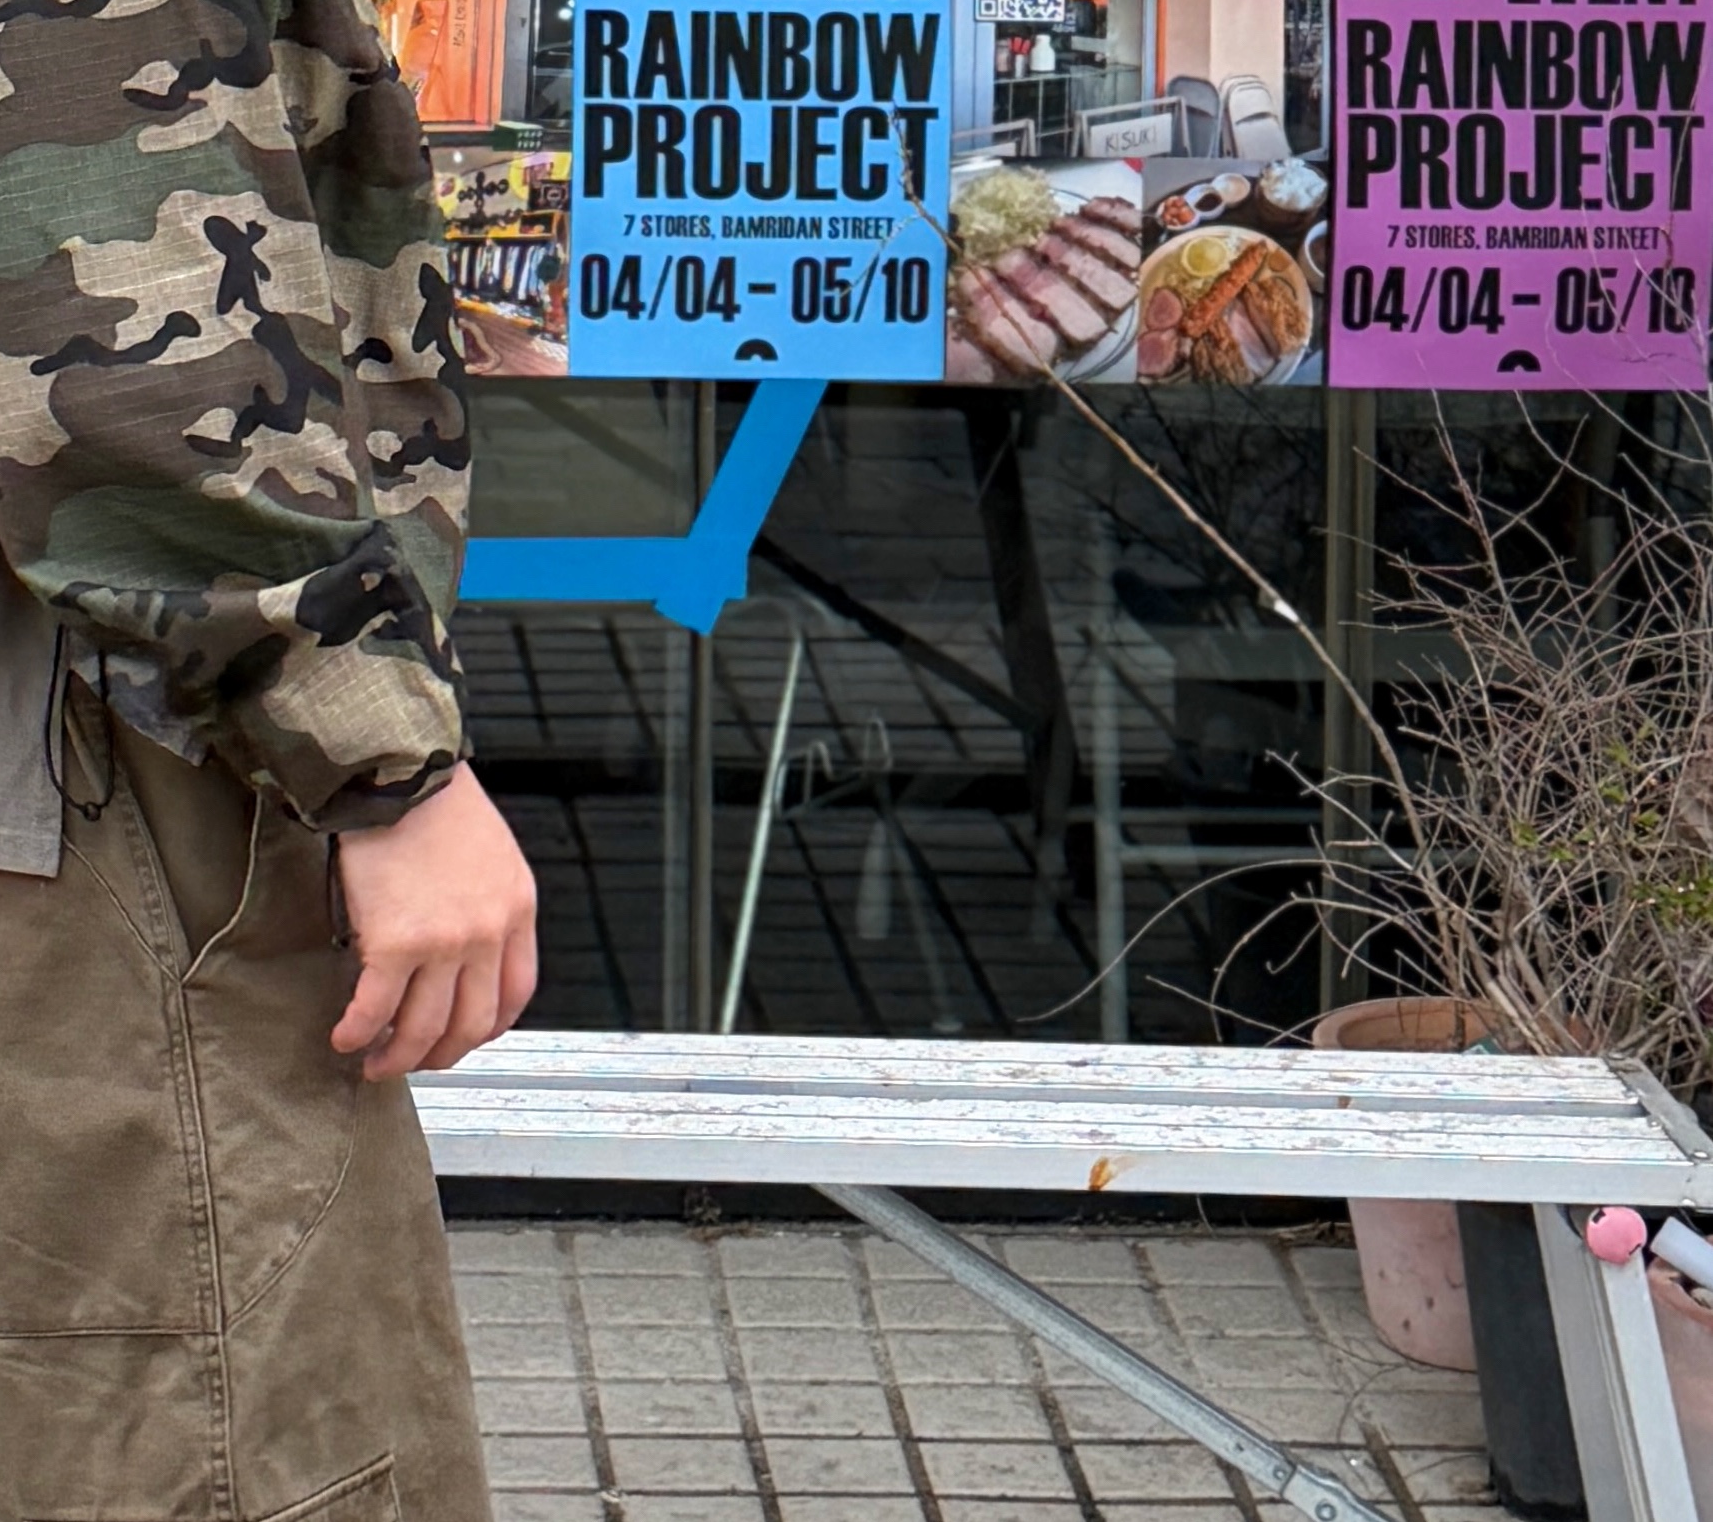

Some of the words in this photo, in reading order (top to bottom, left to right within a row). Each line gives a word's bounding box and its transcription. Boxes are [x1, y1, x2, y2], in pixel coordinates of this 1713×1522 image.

[585, 11, 938, 101] RAINBOW
[1347, 19, 1705, 111] RAINBOW
[584, 104, 937, 202] PROJECT
[1105, 125, 1157, 155] KISUKI
[1347, 113, 1704, 211] PROJECT
[624, 215, 635, 235] 7
[642, 215, 715, 240] STORES,
[722, 216, 822, 238] BAMRIDAN
[829, 217, 893, 240] STREET
[1388, 225, 1400, 247] 7
[1406, 225, 1479, 249] STORES,
[1487, 227, 1587, 249] BAMRIDAN
[1594, 227, 1659, 249] STREET
[582, 255, 739, 321] 04/04
[793, 258, 929, 322] 05/10
[1342, 265, 1504, 334] 04/04
[1555, 264, 1695, 334] 05/10
